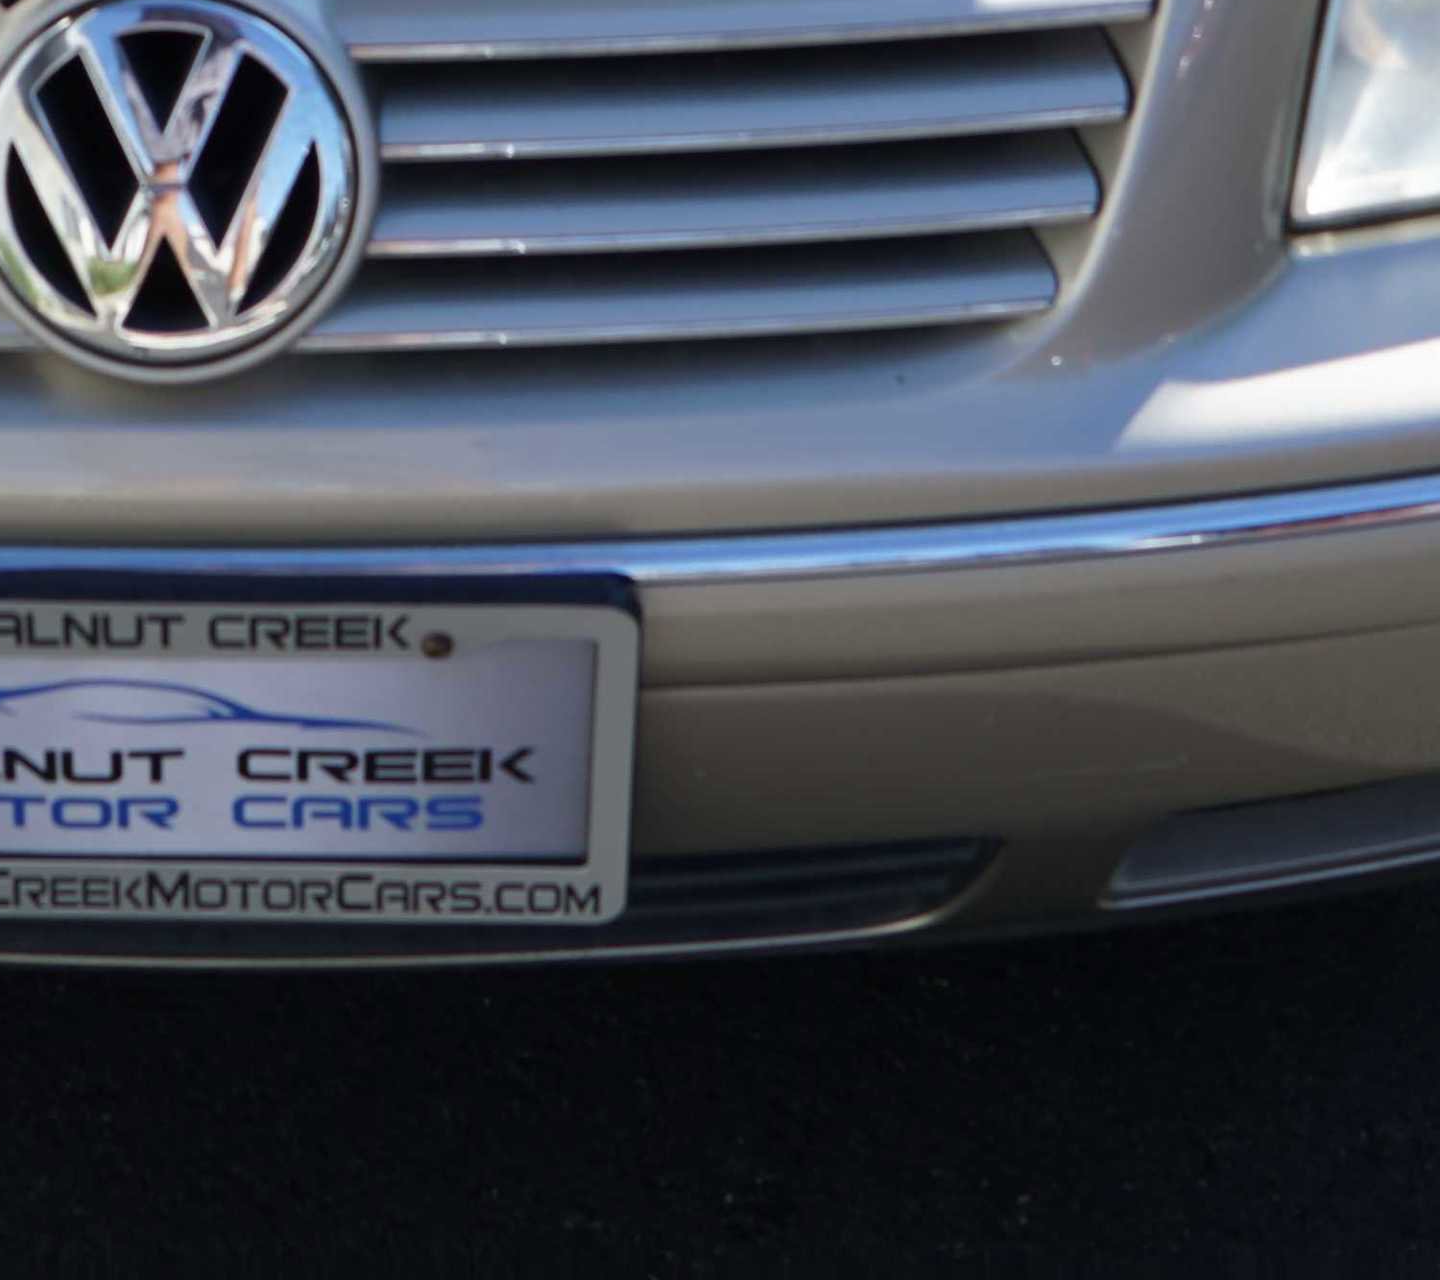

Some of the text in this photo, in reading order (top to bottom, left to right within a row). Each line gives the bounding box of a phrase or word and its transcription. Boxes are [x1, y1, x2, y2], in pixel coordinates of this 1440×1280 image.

[207, 613, 411, 651] CREEK
[237, 747, 535, 783] CREEK
[231, 794, 484, 831] CARS
